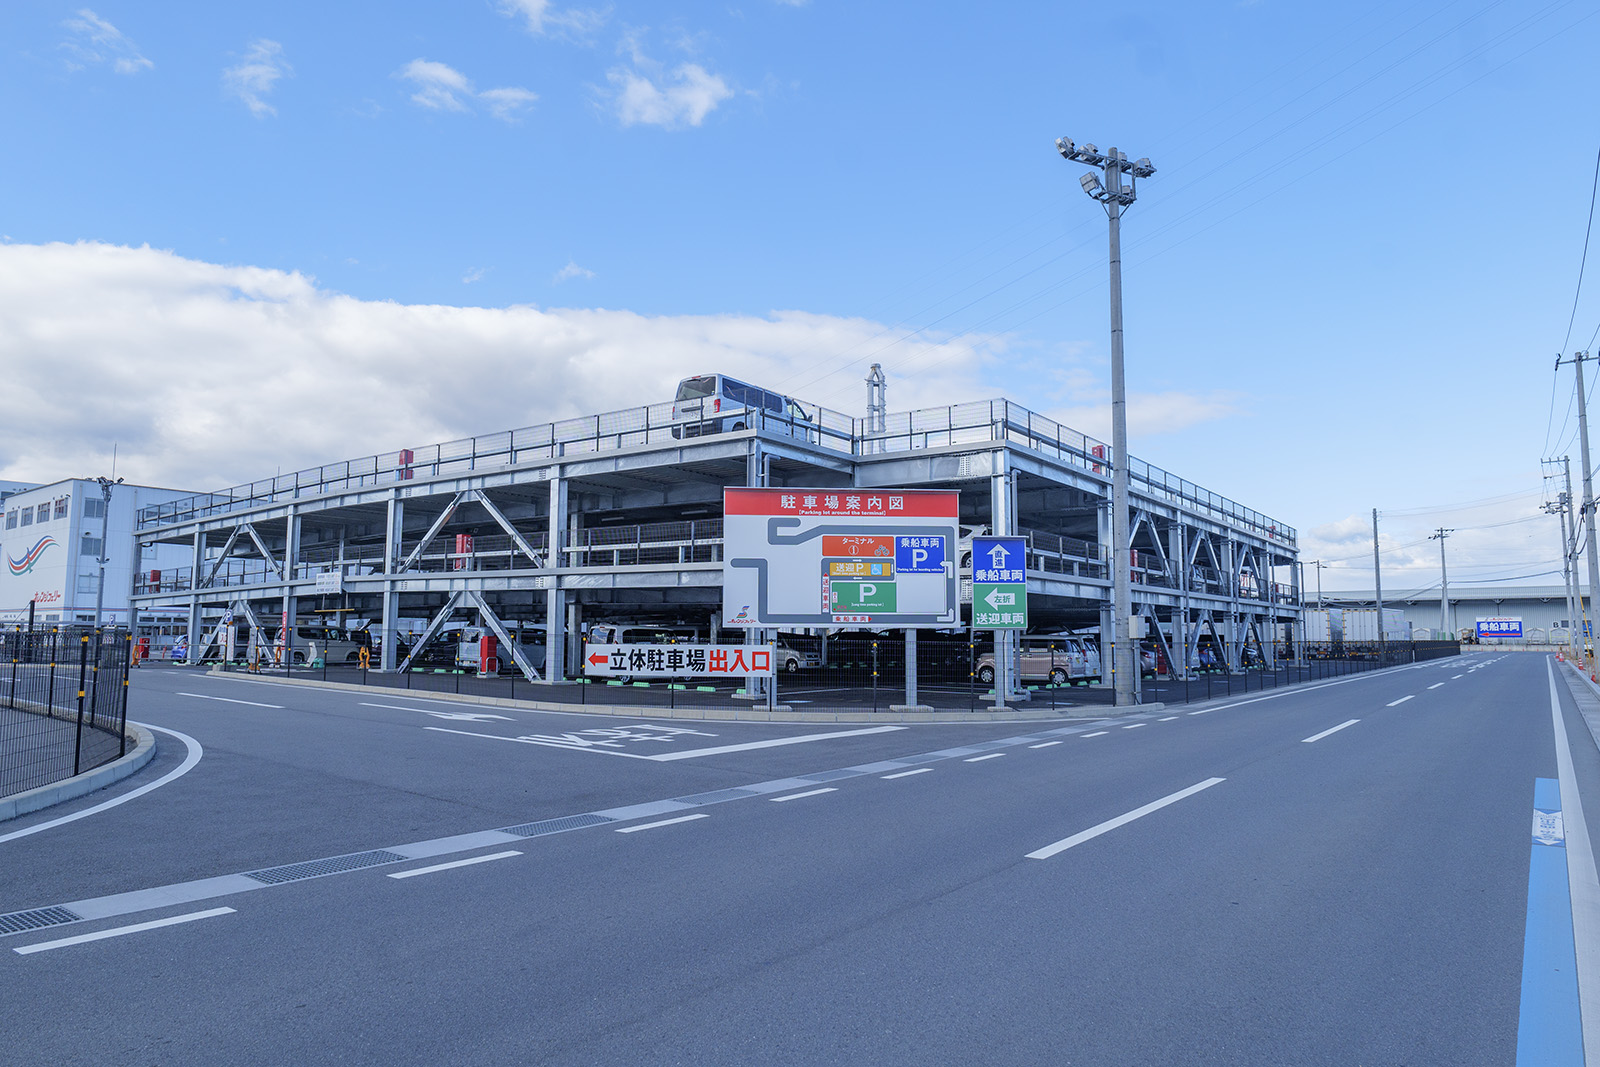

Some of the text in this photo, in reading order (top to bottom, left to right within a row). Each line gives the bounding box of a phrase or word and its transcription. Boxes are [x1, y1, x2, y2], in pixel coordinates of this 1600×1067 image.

[780, 494, 904, 510] 駐車場案内図
[842, 537, 875, 545] ターミナル
[901, 538, 940, 548] 乗船車両
[912, 548, 928, 568] P
[994, 550, 1003, 566] 直進
[976, 570, 1023, 582] 乗船車両
[860, 584, 877, 602] P
[994, 595, 1011, 604] 左折
[976, 612, 1024, 625] 送迎車両
[1479, 622, 1520, 632] 乗船車両
[609, 648, 770, 673] 立体駐車場出入口
